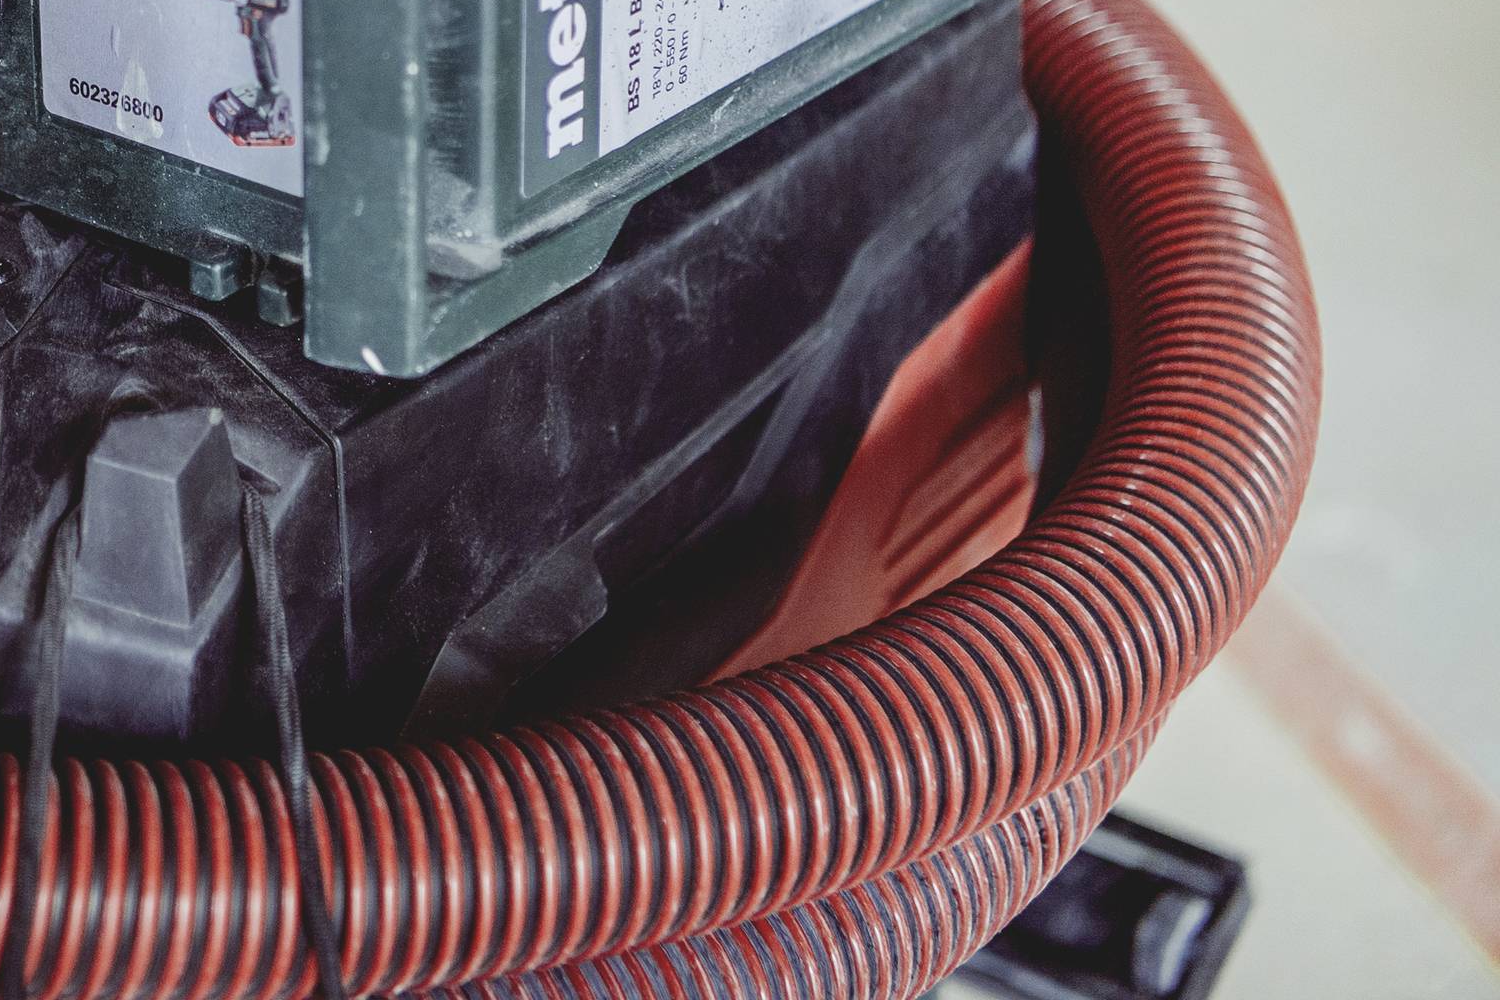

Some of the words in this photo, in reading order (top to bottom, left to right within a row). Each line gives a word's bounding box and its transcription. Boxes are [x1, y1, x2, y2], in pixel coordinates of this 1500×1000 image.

[628, 19, 643, 37] L
[667, 13, 677, 23] 0
[628, 41, 642, 71] 18
[653, 26, 663, 57] 220
[666, 37, 676, 67] 550
[679, 29, 689, 61] Nm
[665, 81, 675, 92] 0
[678, 64, 688, 85] 60
[69, 77, 164, 123] 602326800
[627, 76, 641, 113] BS
